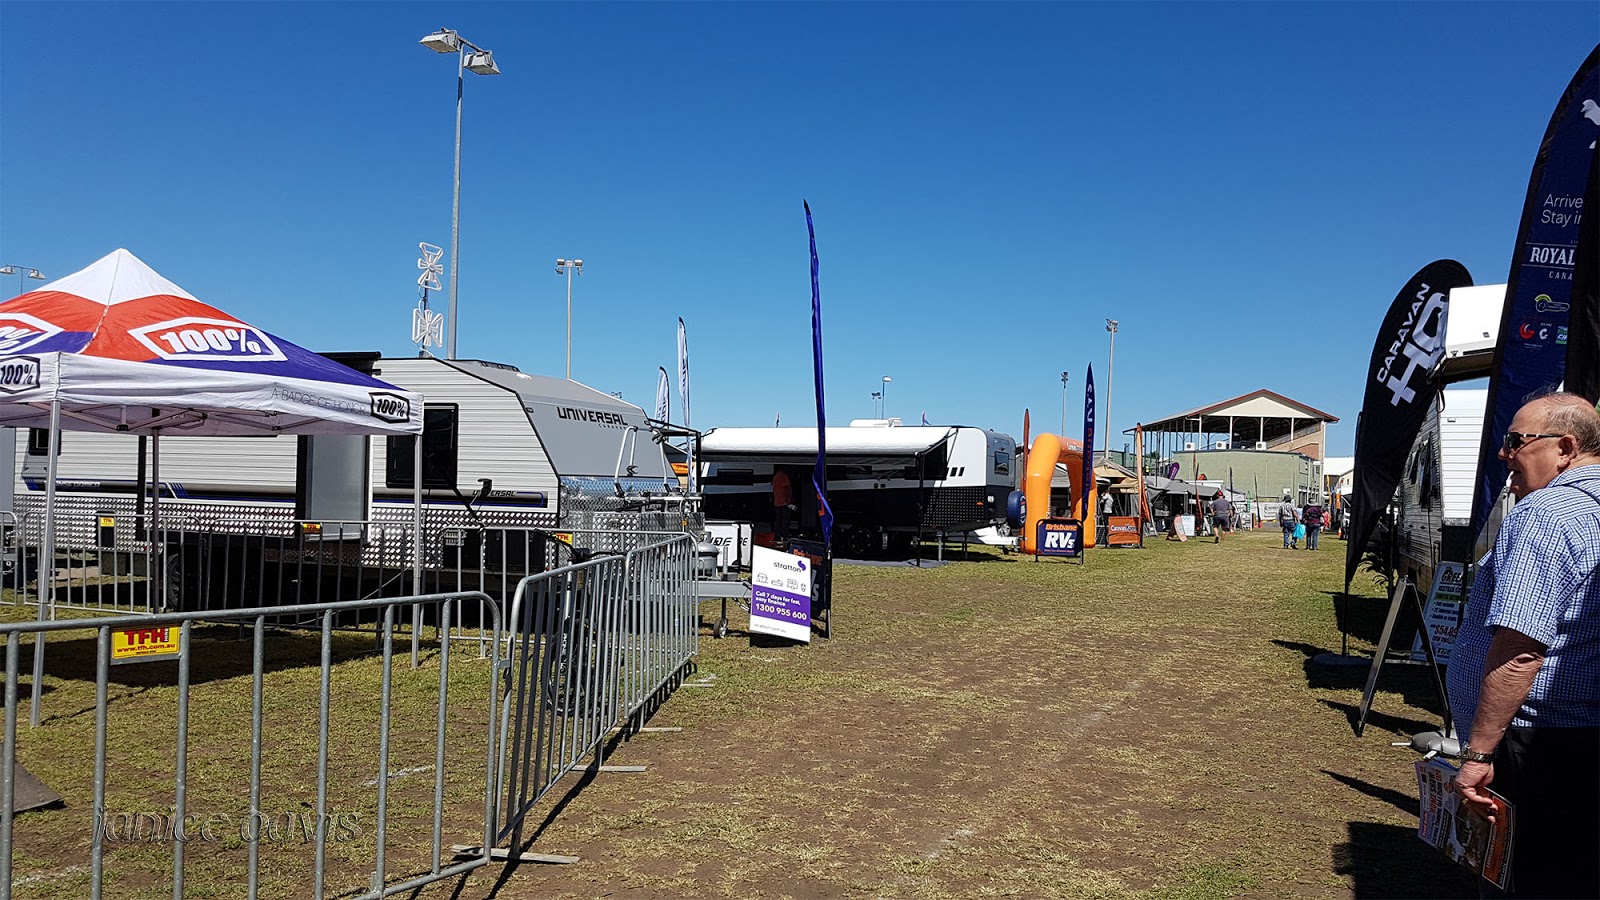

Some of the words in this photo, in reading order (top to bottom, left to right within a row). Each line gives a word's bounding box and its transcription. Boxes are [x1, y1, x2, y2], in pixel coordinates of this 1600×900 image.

[1543, 193, 1583, 209] Arrive
[1541, 209, 1572, 228] Stay
[1529, 246, 1576, 266] ROYAL
[159, 329, 262, 353] 100%
[1376, 283, 1430, 383] CARAVAN
[0, 364, 34, 385] 100%
[281, 389, 314, 405] BADGE
[318, 396, 331, 408] OF
[334, 399, 366, 415] HONOR
[376, 398, 405, 417] 100%
[557, 406, 629, 426] UNIVERSAL
[472, 489, 516, 497] UERSAL
[1045, 523, 1078, 531] Brisbane
[1044, 531, 1076, 549] RVs
[773, 561, 802, 573] stratton
[755, 590, 766, 598] Call
[770, 593, 782, 601] days
[790, 598, 801, 606] fast,
[767, 598, 786, 606] finance
[755, 603, 775, 613] 1300
[776, 606, 791, 616] 955
[792, 610, 807, 620] 600
[124, 627, 165, 645] TFH
[117, 643, 176, 653] www.tfh.com.au
